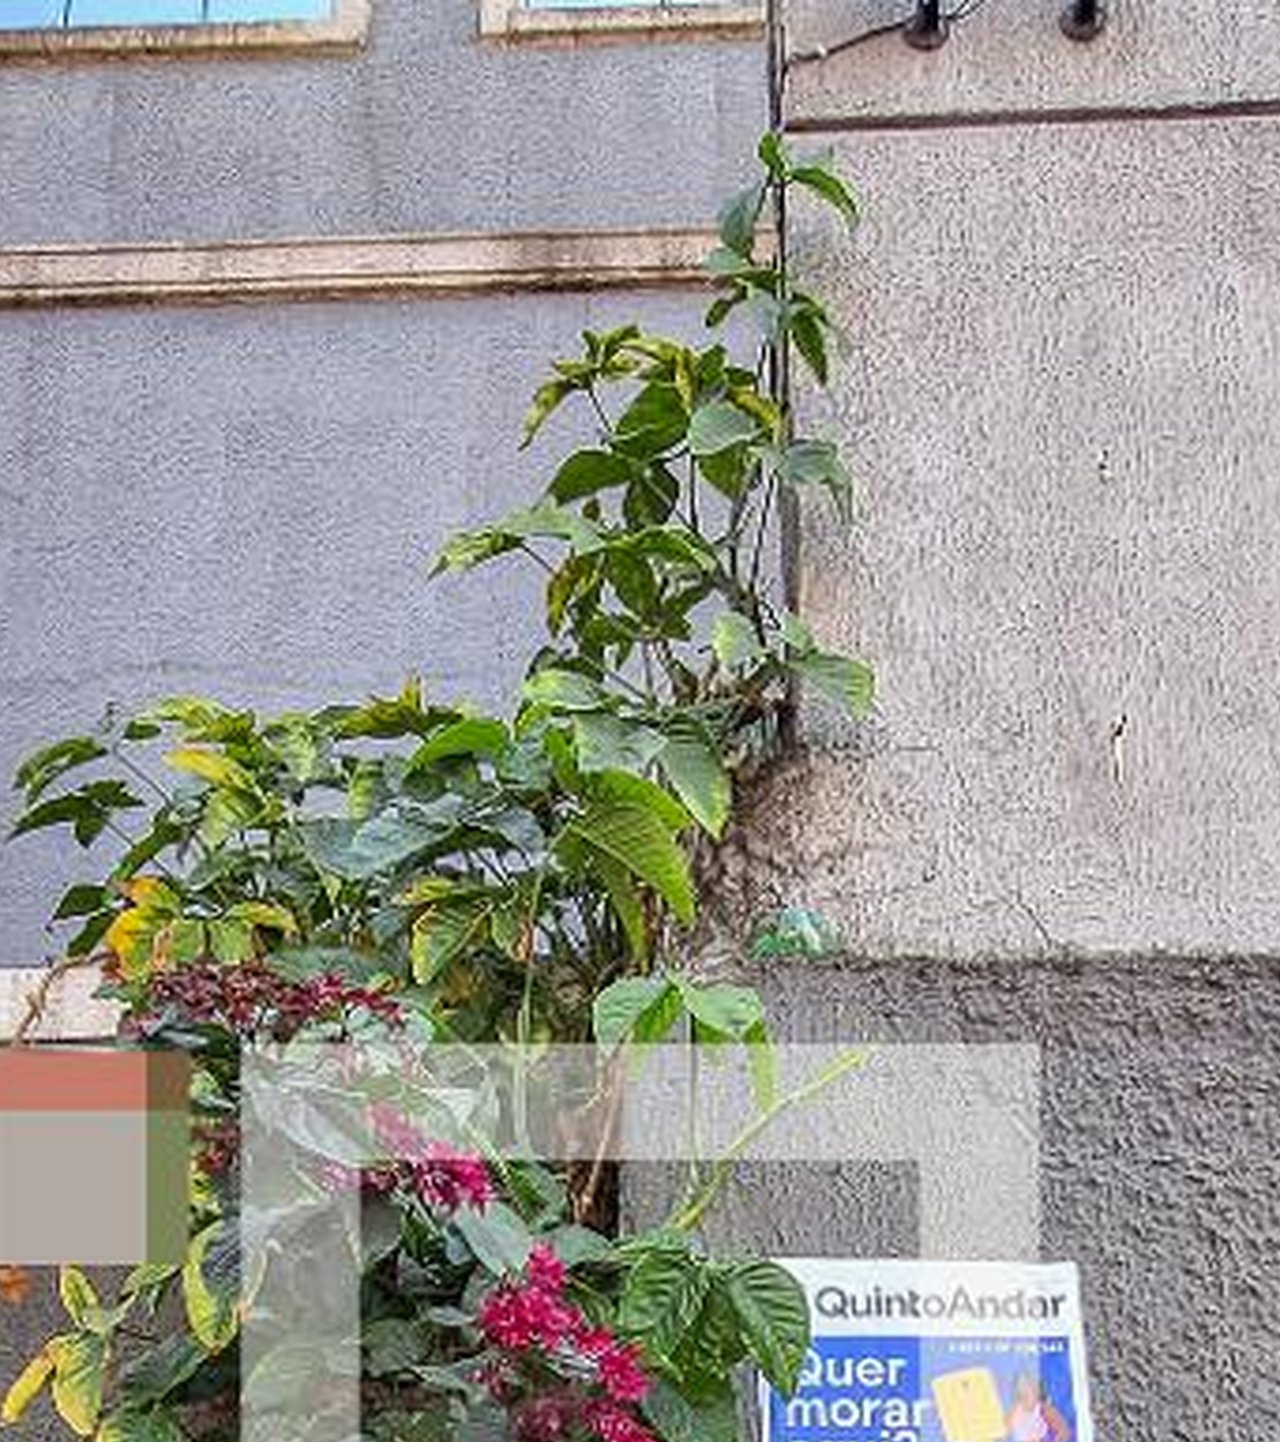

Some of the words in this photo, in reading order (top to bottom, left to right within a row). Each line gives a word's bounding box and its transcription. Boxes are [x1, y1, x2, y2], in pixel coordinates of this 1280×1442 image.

[815, 1285, 1067, 1320] QuintoAndar
[798, 1347, 907, 1388] Quer
[786, 1397, 930, 1429] morar
